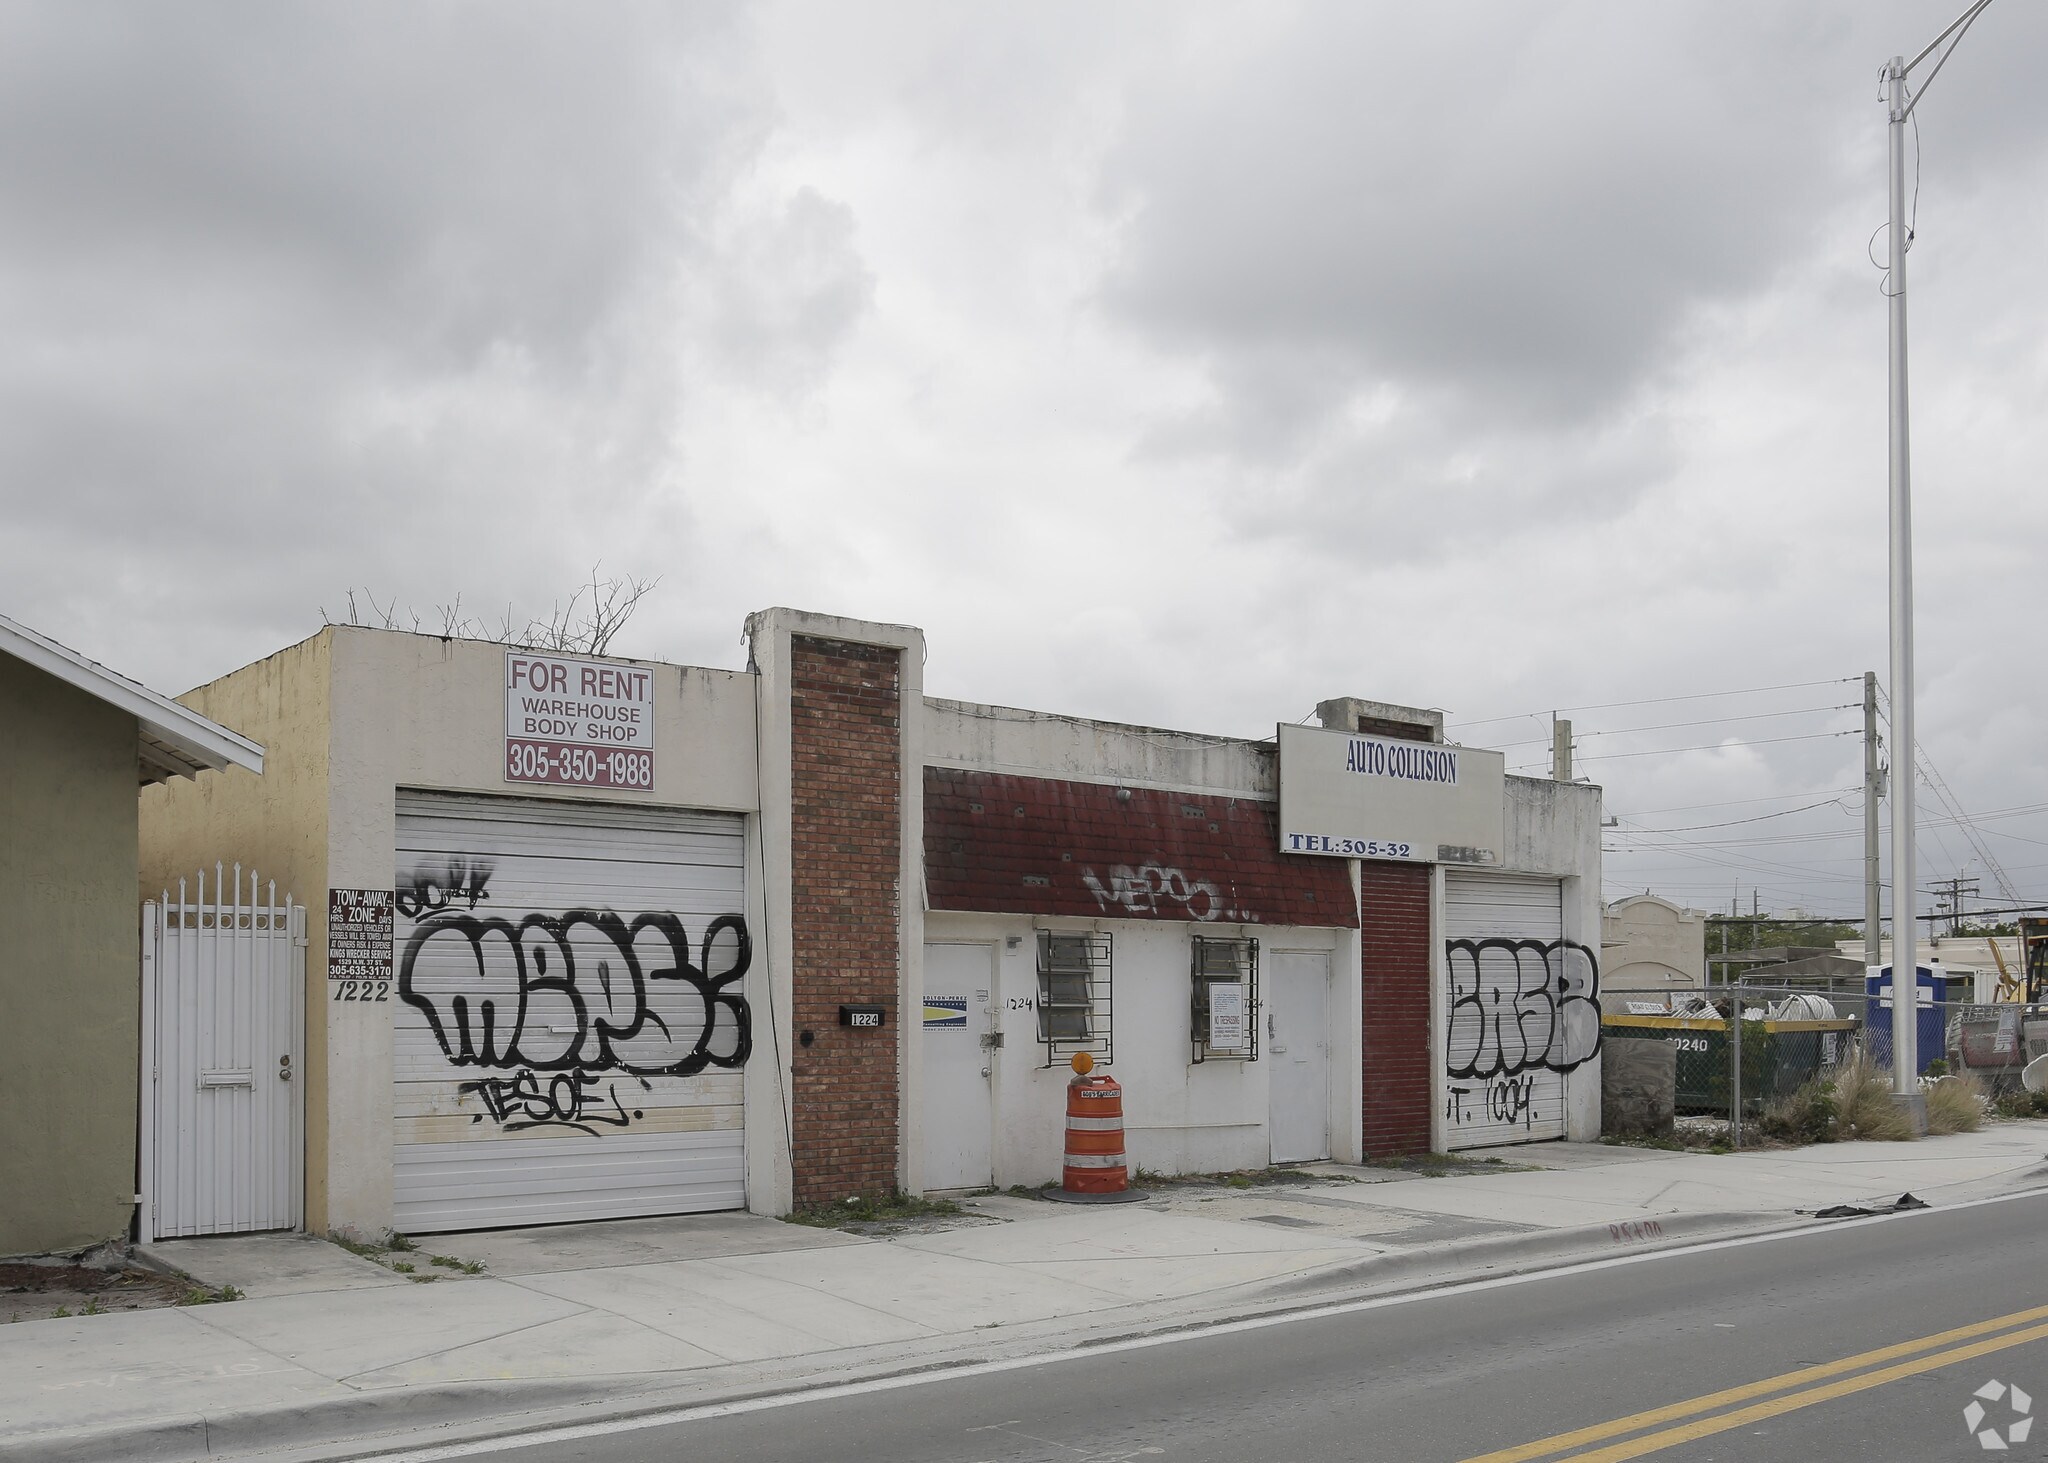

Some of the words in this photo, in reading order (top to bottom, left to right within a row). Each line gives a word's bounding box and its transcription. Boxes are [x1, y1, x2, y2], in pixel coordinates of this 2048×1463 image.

[512, 660, 567, 694] FOR
[581, 667, 648, 702] RENT
[522, 697, 641, 723] WAREHOUSE
[525, 718, 578, 736] BODY
[587, 723, 637, 741] SHOP
[510, 744, 651, 786] 305-350-1988
[1346, 739, 1384, 775] AUTO
[1388, 745, 1457, 784] COLLISION
[1289, 833, 1410, 857] TEL:305-32
[335, 890, 388, 907] TOW-AWAY
[332, 905, 342, 913] 24
[348, 906, 376, 923] ZONE
[382, 907, 389, 915] 7
[330, 914, 344, 922] HRS
[329, 949, 346, 958] KINGS
[346, 949, 370, 959] WRECKER
[371, 949, 392, 959] SERVICE
[329, 965, 391, 975] 305-635-3170
[334, 980, 389, 1002] 1222
[1006, 997, 1033, 1012] 1224
[853, 1014, 878, 1025] 1224
